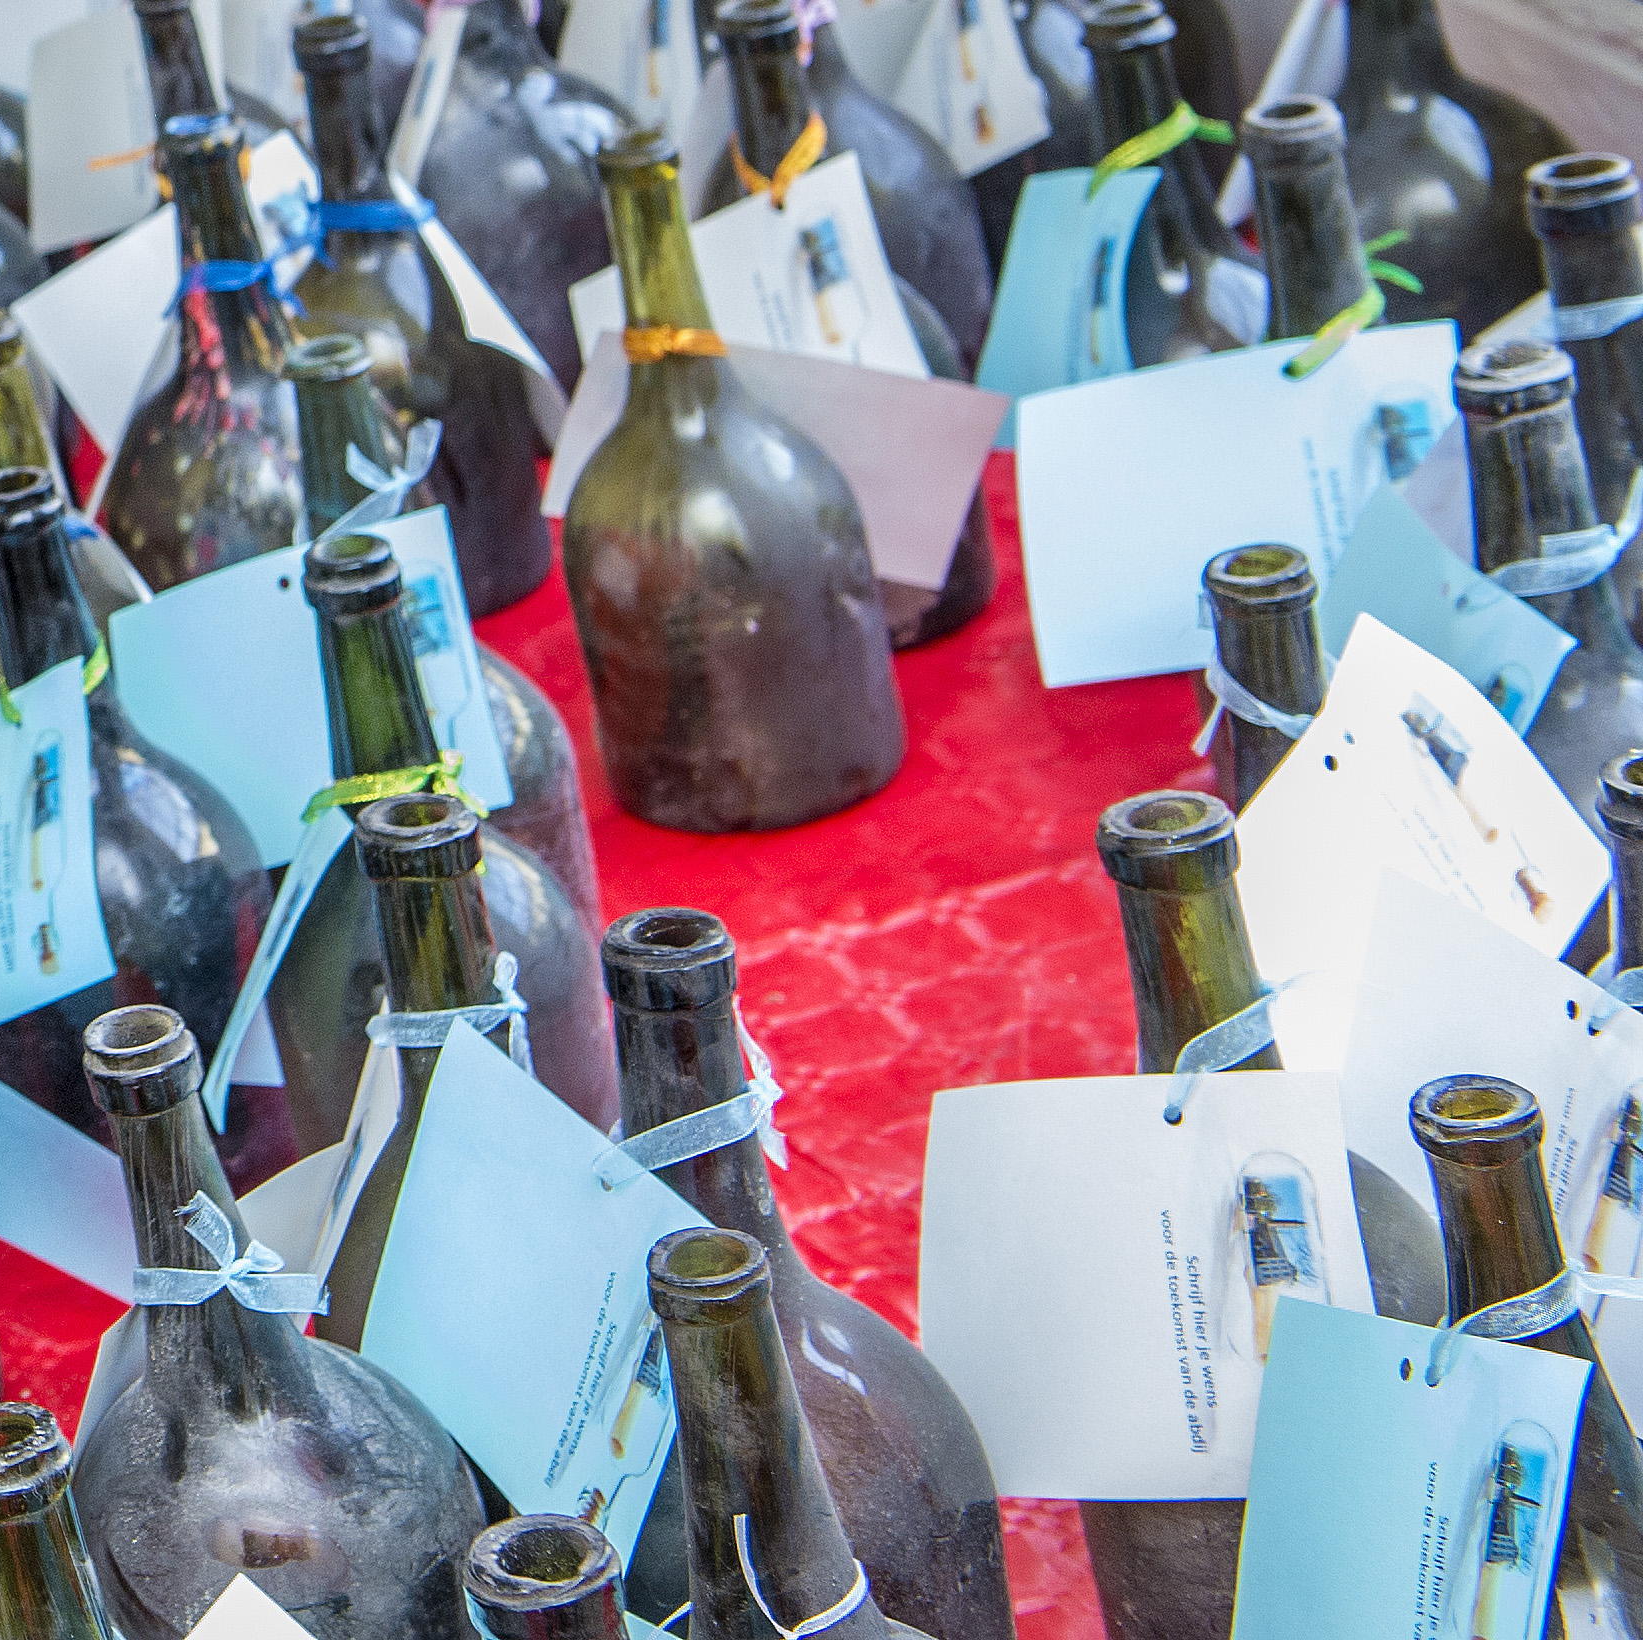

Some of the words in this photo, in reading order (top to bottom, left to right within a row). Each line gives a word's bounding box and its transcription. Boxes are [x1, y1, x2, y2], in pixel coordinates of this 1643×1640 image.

[1161, 1209, 1174, 1246] voor
[1165, 1250, 1181, 1271] de
[603, 1271, 617, 1305] voor
[1186, 1255, 1206, 1307] Schrijf
[597, 1307, 607, 1327] de
[1168, 1275, 1188, 1353] toekomst
[1193, 1311, 1207, 1342] hier
[598, 1321, 617, 1370] Schrijf
[1195, 1345, 1212, 1361] je
[575, 1329, 602, 1398] toekomst
[1179, 1356, 1193, 1385] van
[589, 1369, 603, 1399] hier
[1184, 1389, 1199, 1410] de
[1202, 1365, 1218, 1409] wens
[566, 1401, 579, 1427] van
[583, 1399, 593, 1417] je
[558, 1429, 568, 1448] de
[568, 1419, 587, 1456] wens
[1188, 1413, 1208, 1454] abdij
[1426, 1461, 1438, 1501] voor
[1424, 1505, 1434, 1528] de
[1433, 1515, 1449, 1571] Schrijf
[1415, 1533, 1432, 1617] toekomst
[1431, 1575, 1444, 1609] hier
[1414, 1622, 1423, 1640] va
[1429, 1613, 1440, 1631] je
